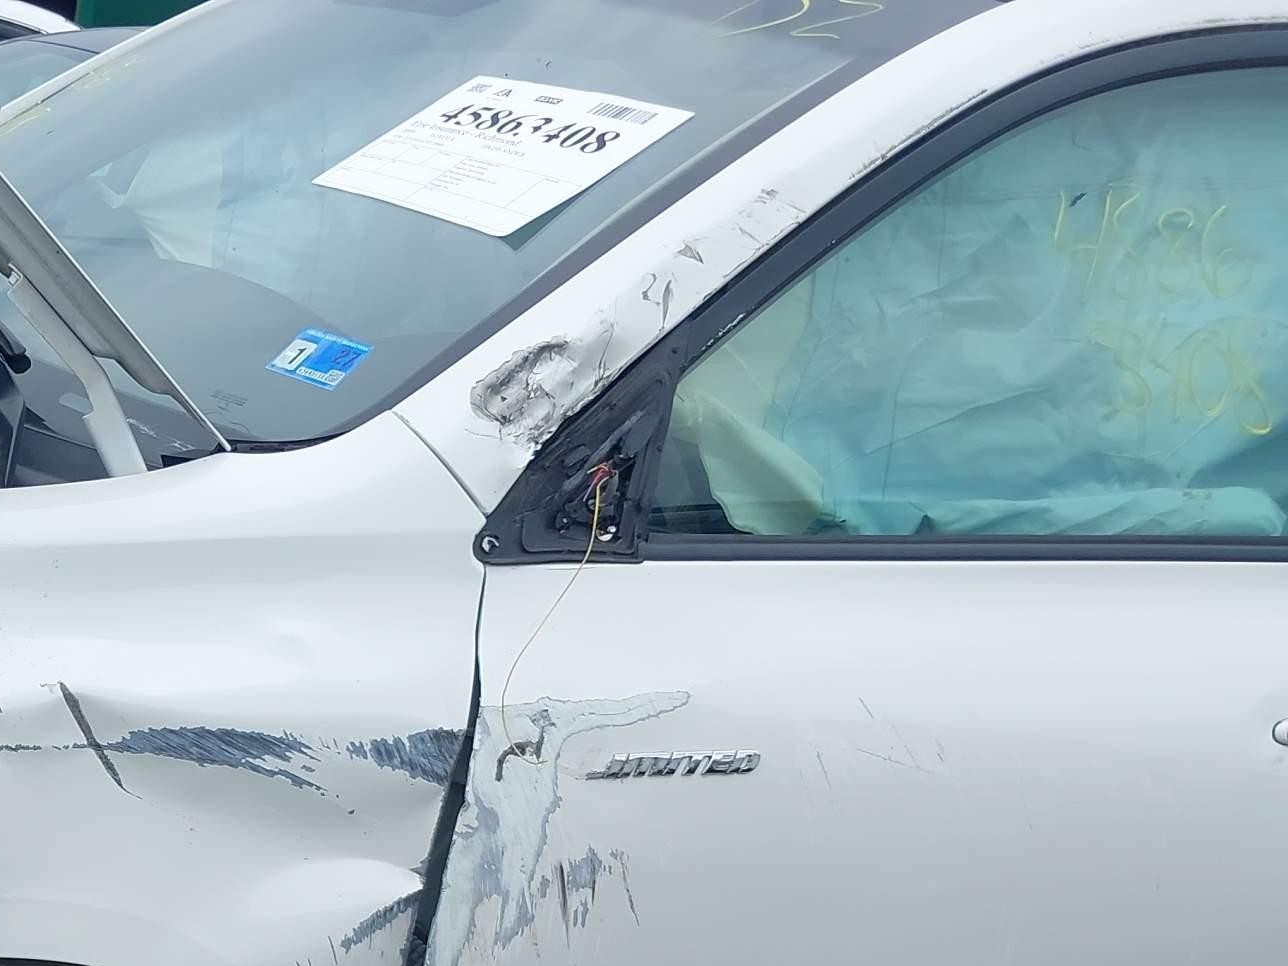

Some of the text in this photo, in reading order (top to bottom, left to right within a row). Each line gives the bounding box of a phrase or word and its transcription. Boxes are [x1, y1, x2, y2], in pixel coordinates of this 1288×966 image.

[440, 104, 621, 154] 45863408
[288, 347, 307, 365] 1
[585, 749, 761, 781] LIMITED
